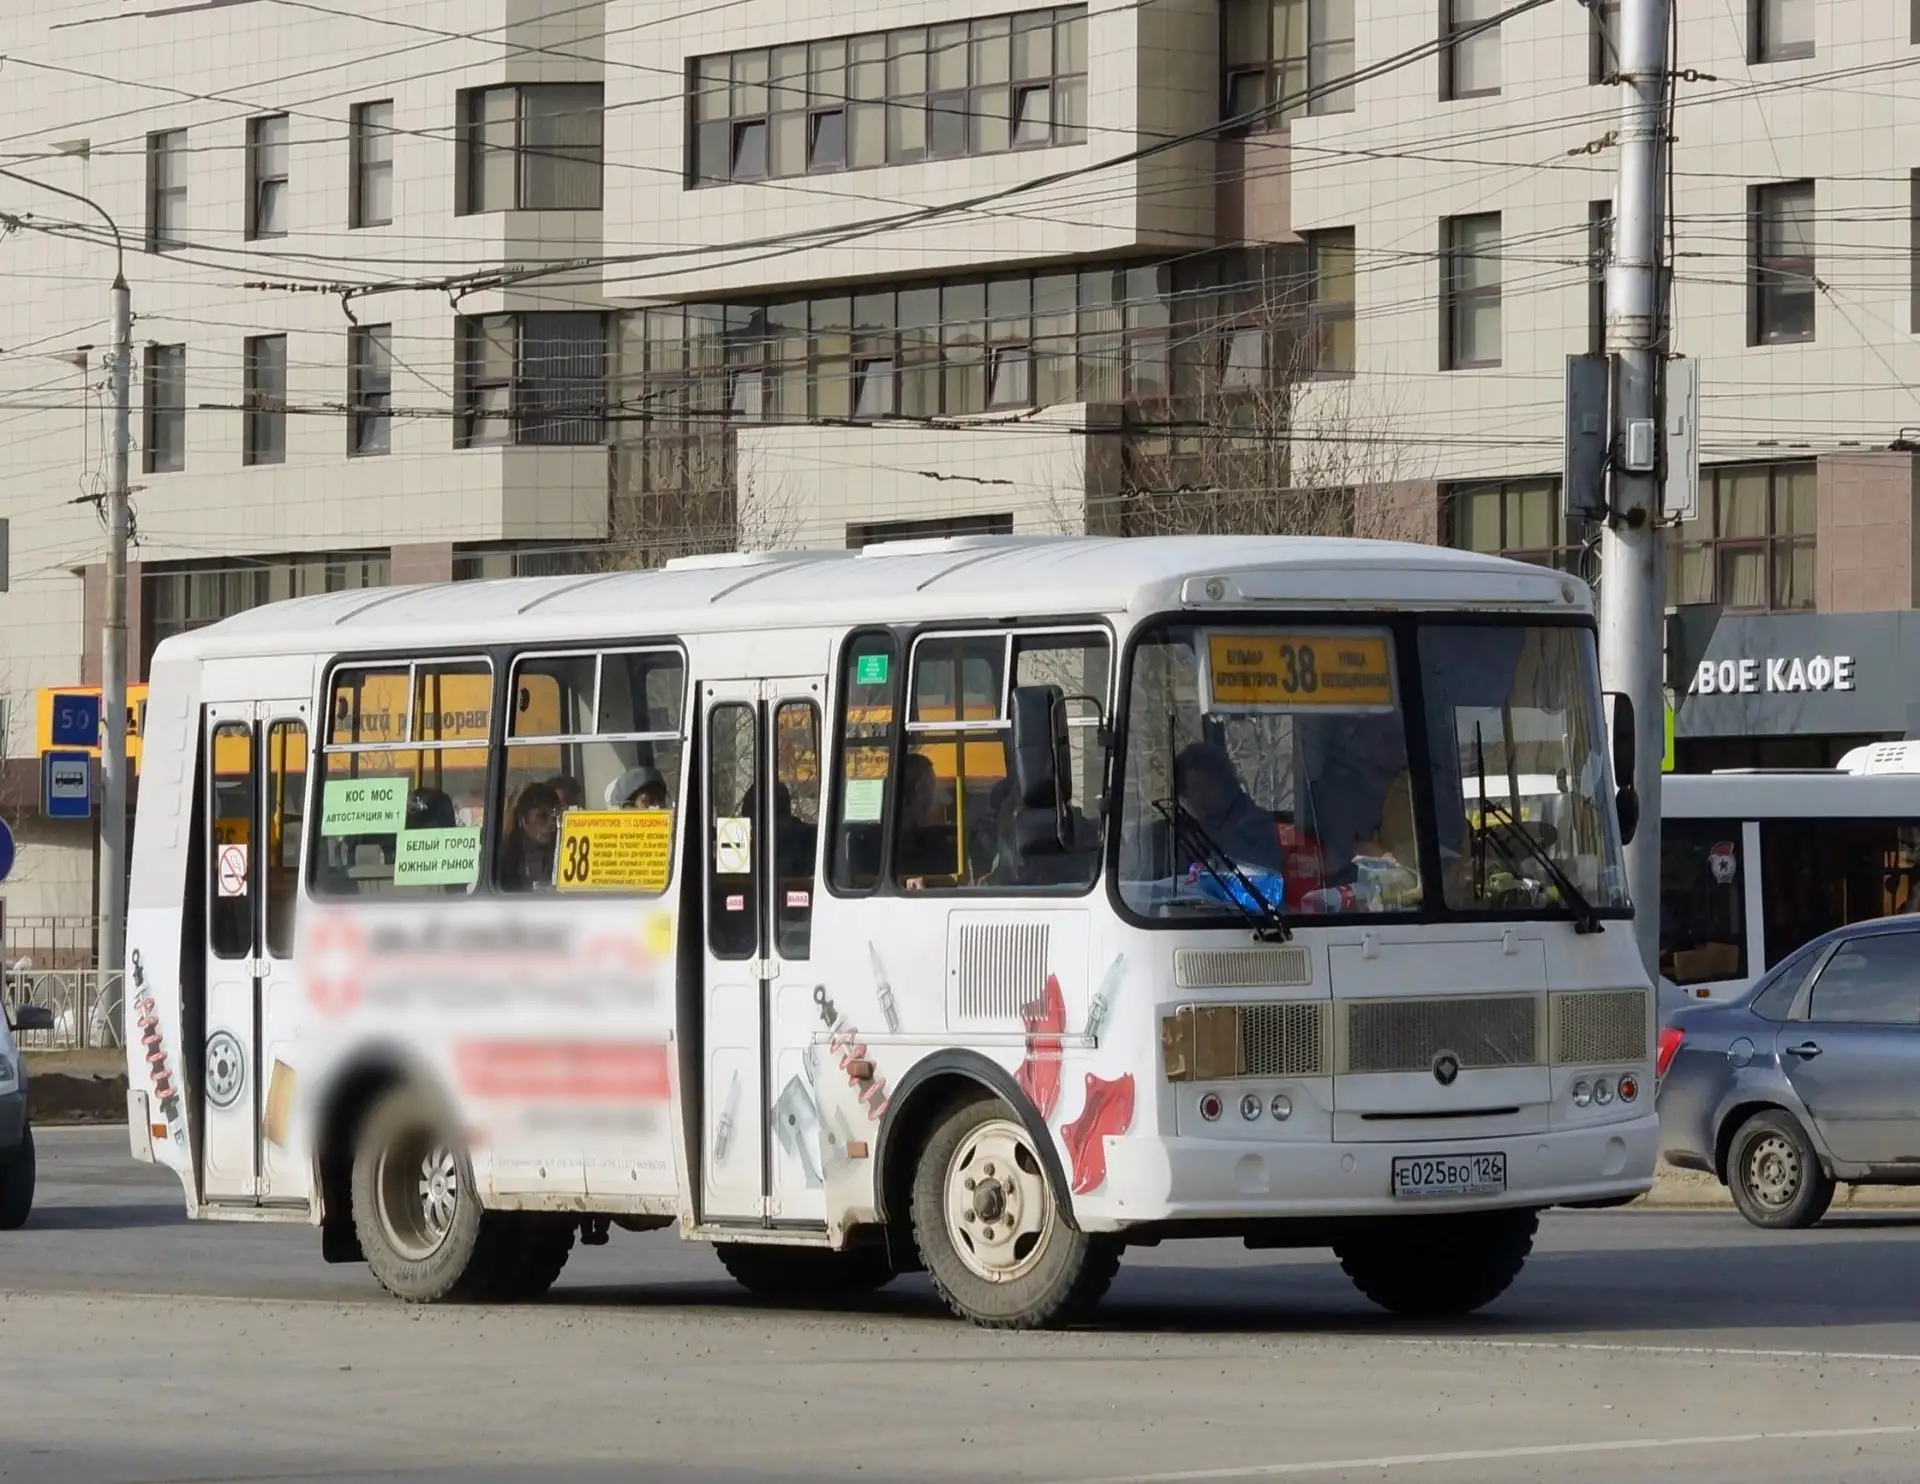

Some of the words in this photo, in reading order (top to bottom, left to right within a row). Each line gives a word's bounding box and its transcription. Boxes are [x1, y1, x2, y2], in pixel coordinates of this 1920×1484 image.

[1279, 644, 1318, 694] 38
[1689, 659, 1755, 694] ВОЕ
[1766, 655, 1851, 692] КАФЕ
[60, 708, 89, 730] 50
[345, 790, 365, 802] КОС
[371, 789, 393, 802] МОС
[326, 811, 382, 823] АВТОСТАНЦИЯ
[406, 838, 440, 852] БЕЛЫЙ
[444, 837, 476, 850] ГОРОД
[398, 860, 438, 872] ЮЖНЫЙ
[441, 859, 474, 870] РЫНОК
[563, 836, 590, 882] 38
[1400, 1161, 1470, 1186] Е025ВО
[1473, 1157, 1500, 1177] 126
